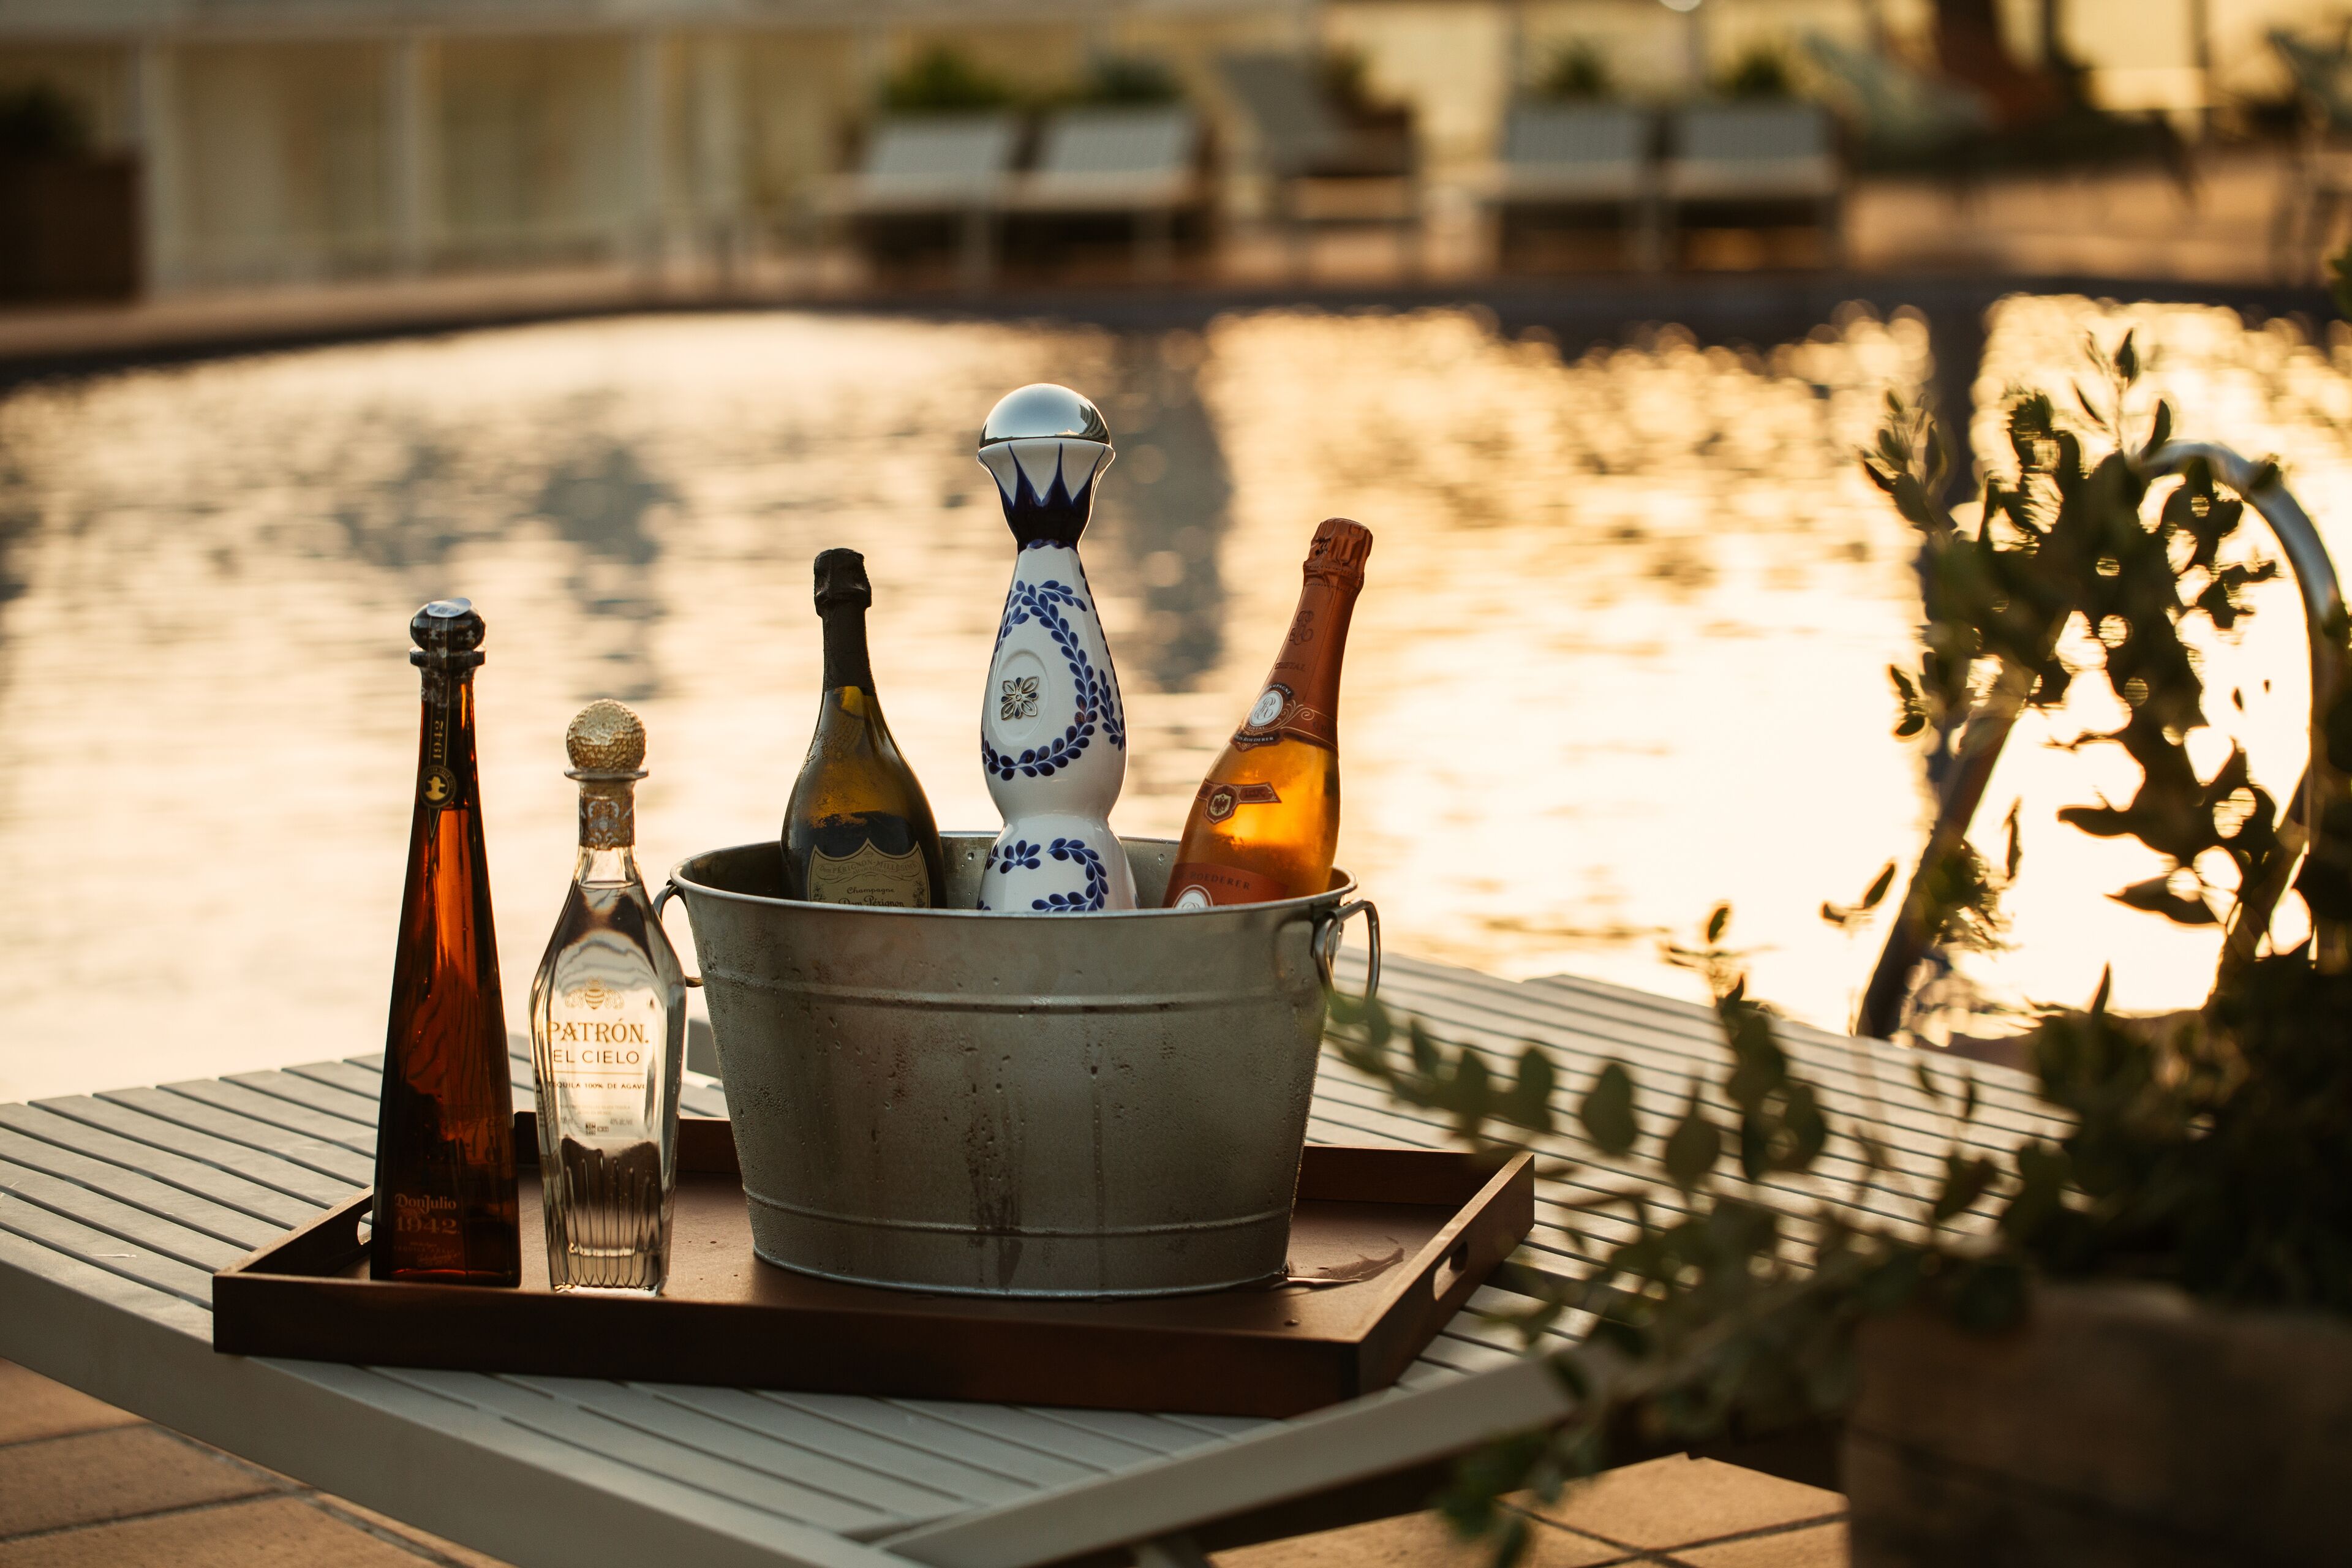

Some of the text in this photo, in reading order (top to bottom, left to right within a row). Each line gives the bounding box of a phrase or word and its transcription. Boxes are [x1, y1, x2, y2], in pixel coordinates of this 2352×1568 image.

[1265, 683, 1292, 696] AMPAGNE
[432, 720, 444, 759] 1942
[1190, 871, 1251, 890] ROEDERER
[838, 895, 905, 907] Dom Pérignon
[553, 1049, 640, 1065] EL CIELO
